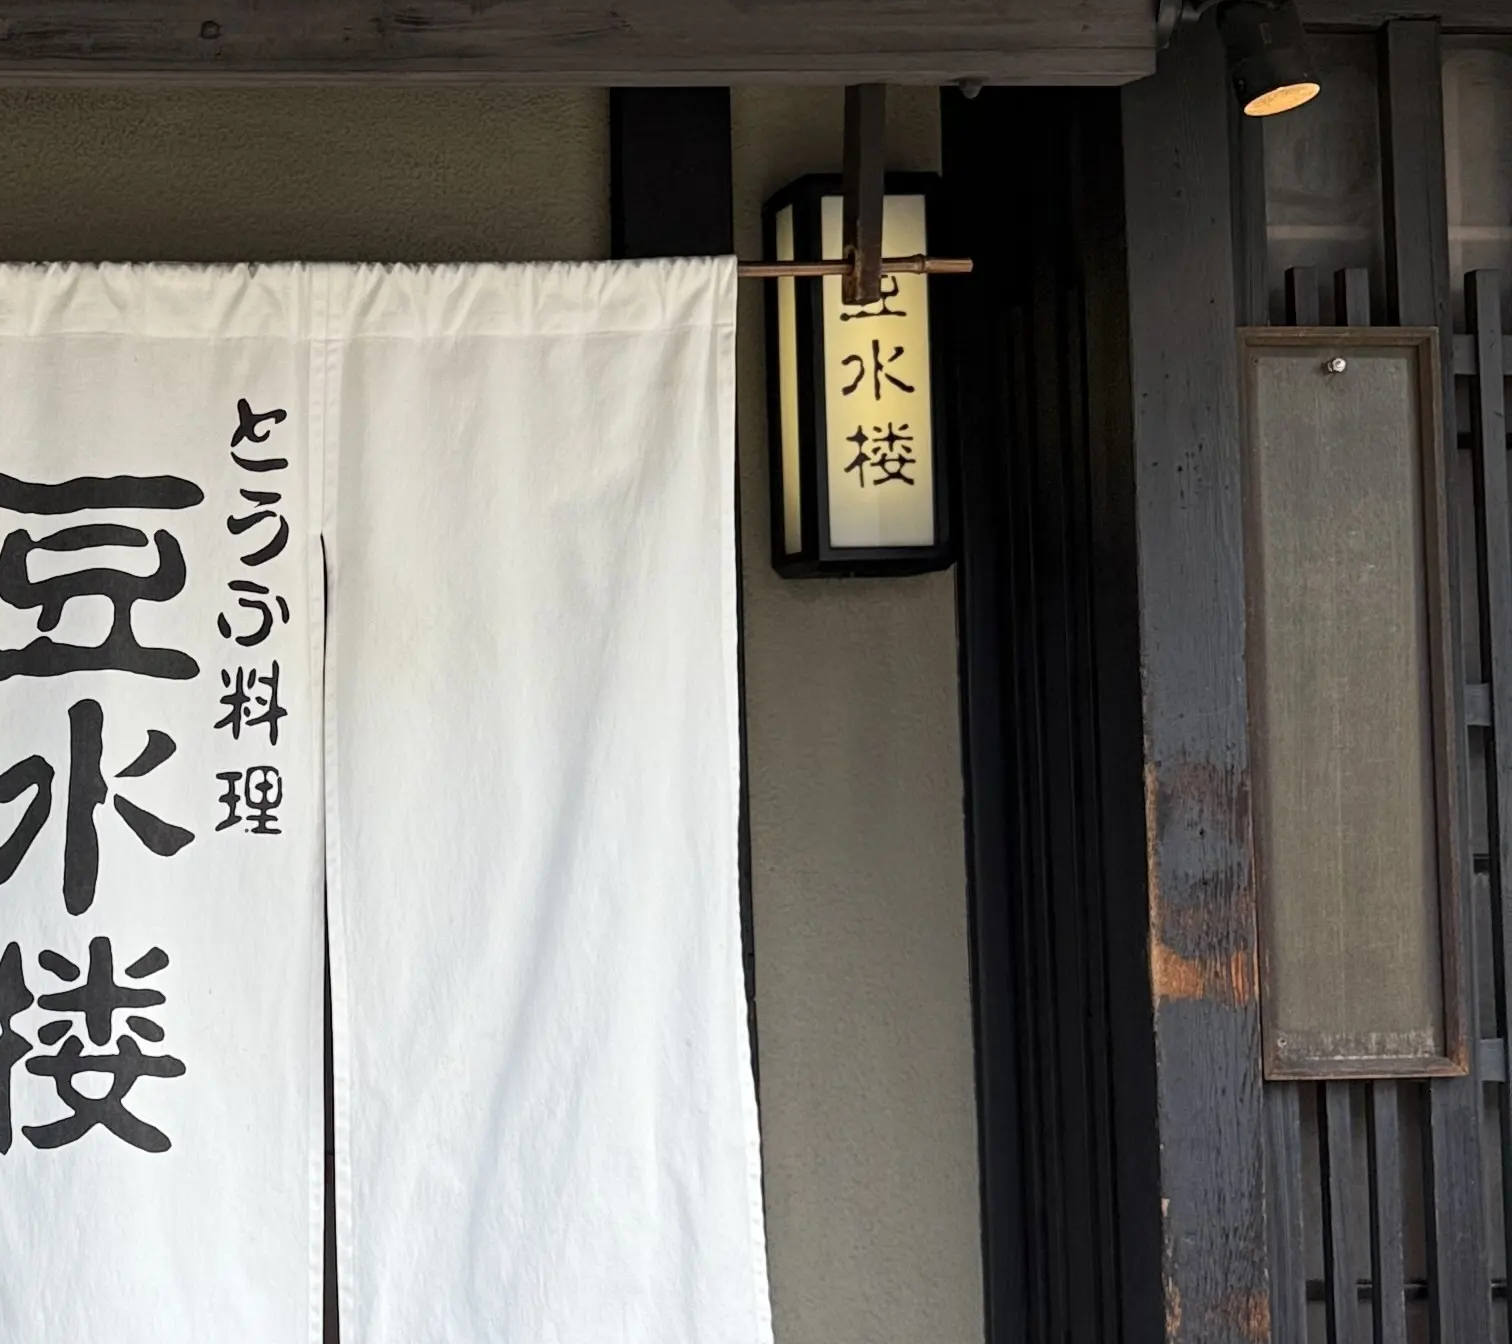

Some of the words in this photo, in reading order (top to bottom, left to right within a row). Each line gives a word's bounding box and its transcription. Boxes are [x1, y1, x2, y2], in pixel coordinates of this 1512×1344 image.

[212, 396, 292, 837] とうふ料理
